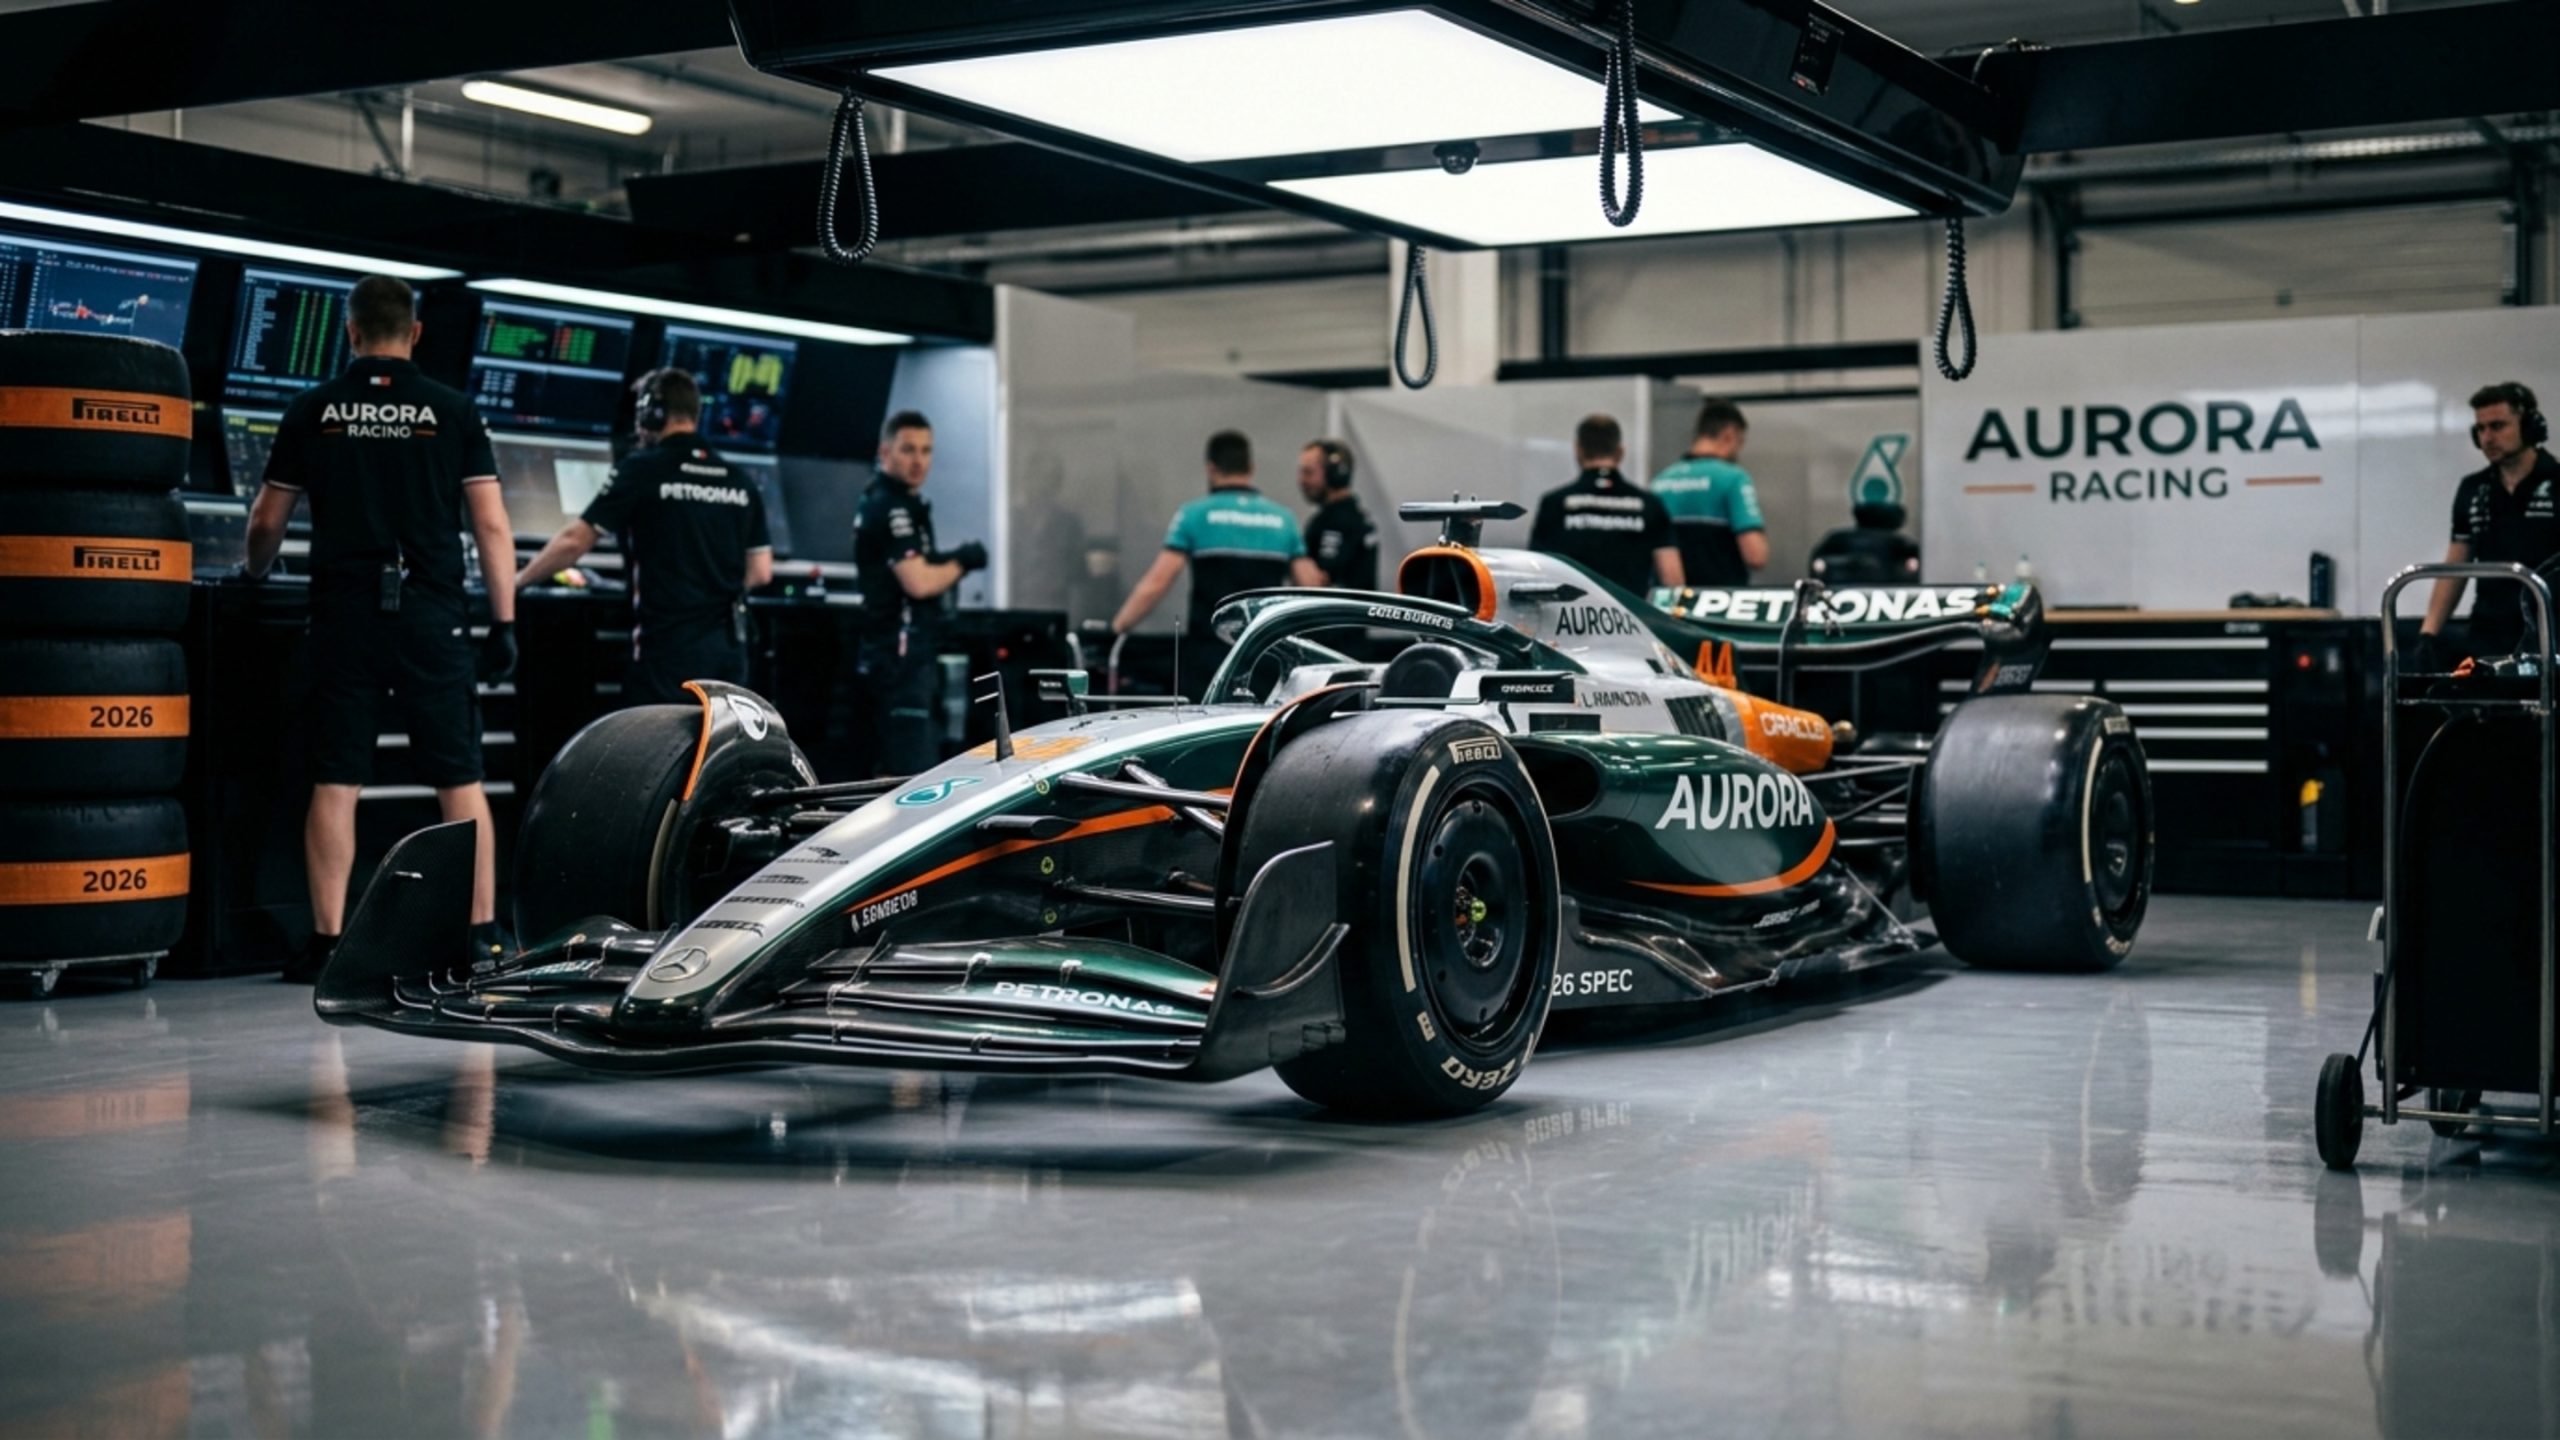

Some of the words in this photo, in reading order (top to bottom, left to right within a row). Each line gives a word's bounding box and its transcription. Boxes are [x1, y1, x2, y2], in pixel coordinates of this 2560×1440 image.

[72, 397, 160, 426] PIRELLI
[321, 403, 438, 425] AURORA
[1964, 398, 2322, 462] AURORA
[2050, 467, 2229, 502] RACING
[73, 545, 161, 571] PIRELLI
[1556, 606, 1642, 636] AURORA
[90, 705, 154, 729] 2026
[1654, 773, 1815, 831] AURORA
[82, 868, 148, 893] 2026
[1552, 972, 1575, 996] 26
[1579, 968, 1633, 995] SPEC
[992, 981, 1175, 1016] PETRONAS
